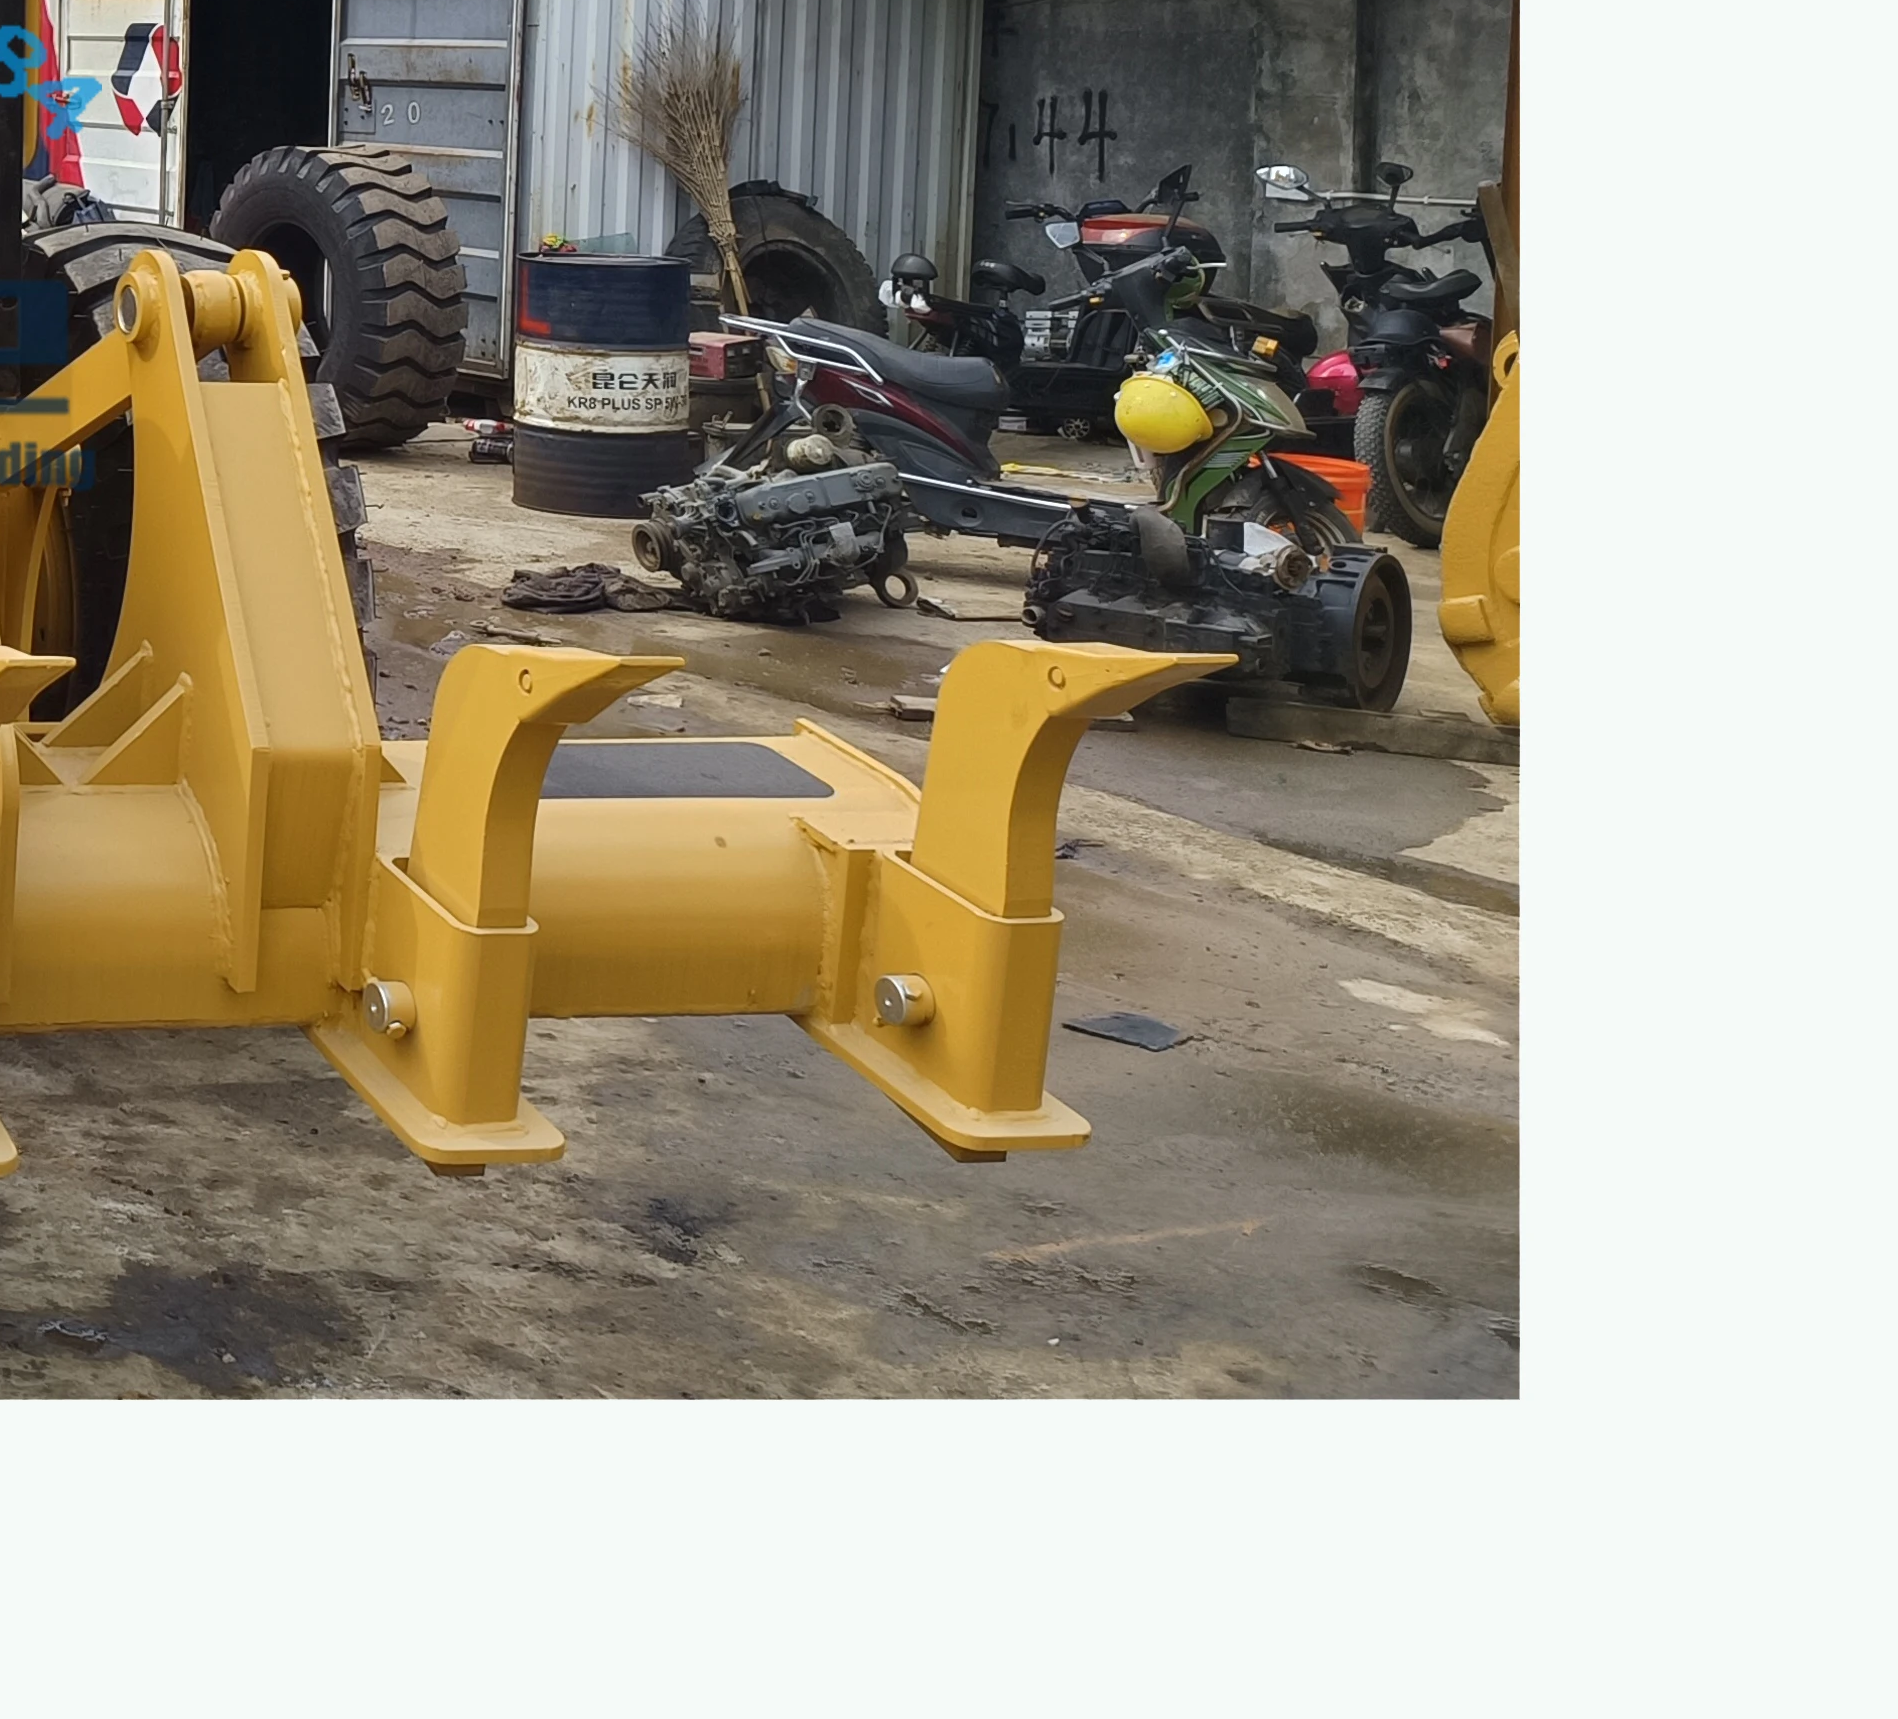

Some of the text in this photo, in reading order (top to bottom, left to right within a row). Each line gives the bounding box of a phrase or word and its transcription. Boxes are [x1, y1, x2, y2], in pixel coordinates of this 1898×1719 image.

[592, 372, 677, 391] 昆仑天润
[567, 396, 597, 410] KR8
[601, 397, 641, 412] PLUS
[645, 397, 662, 410] SP
